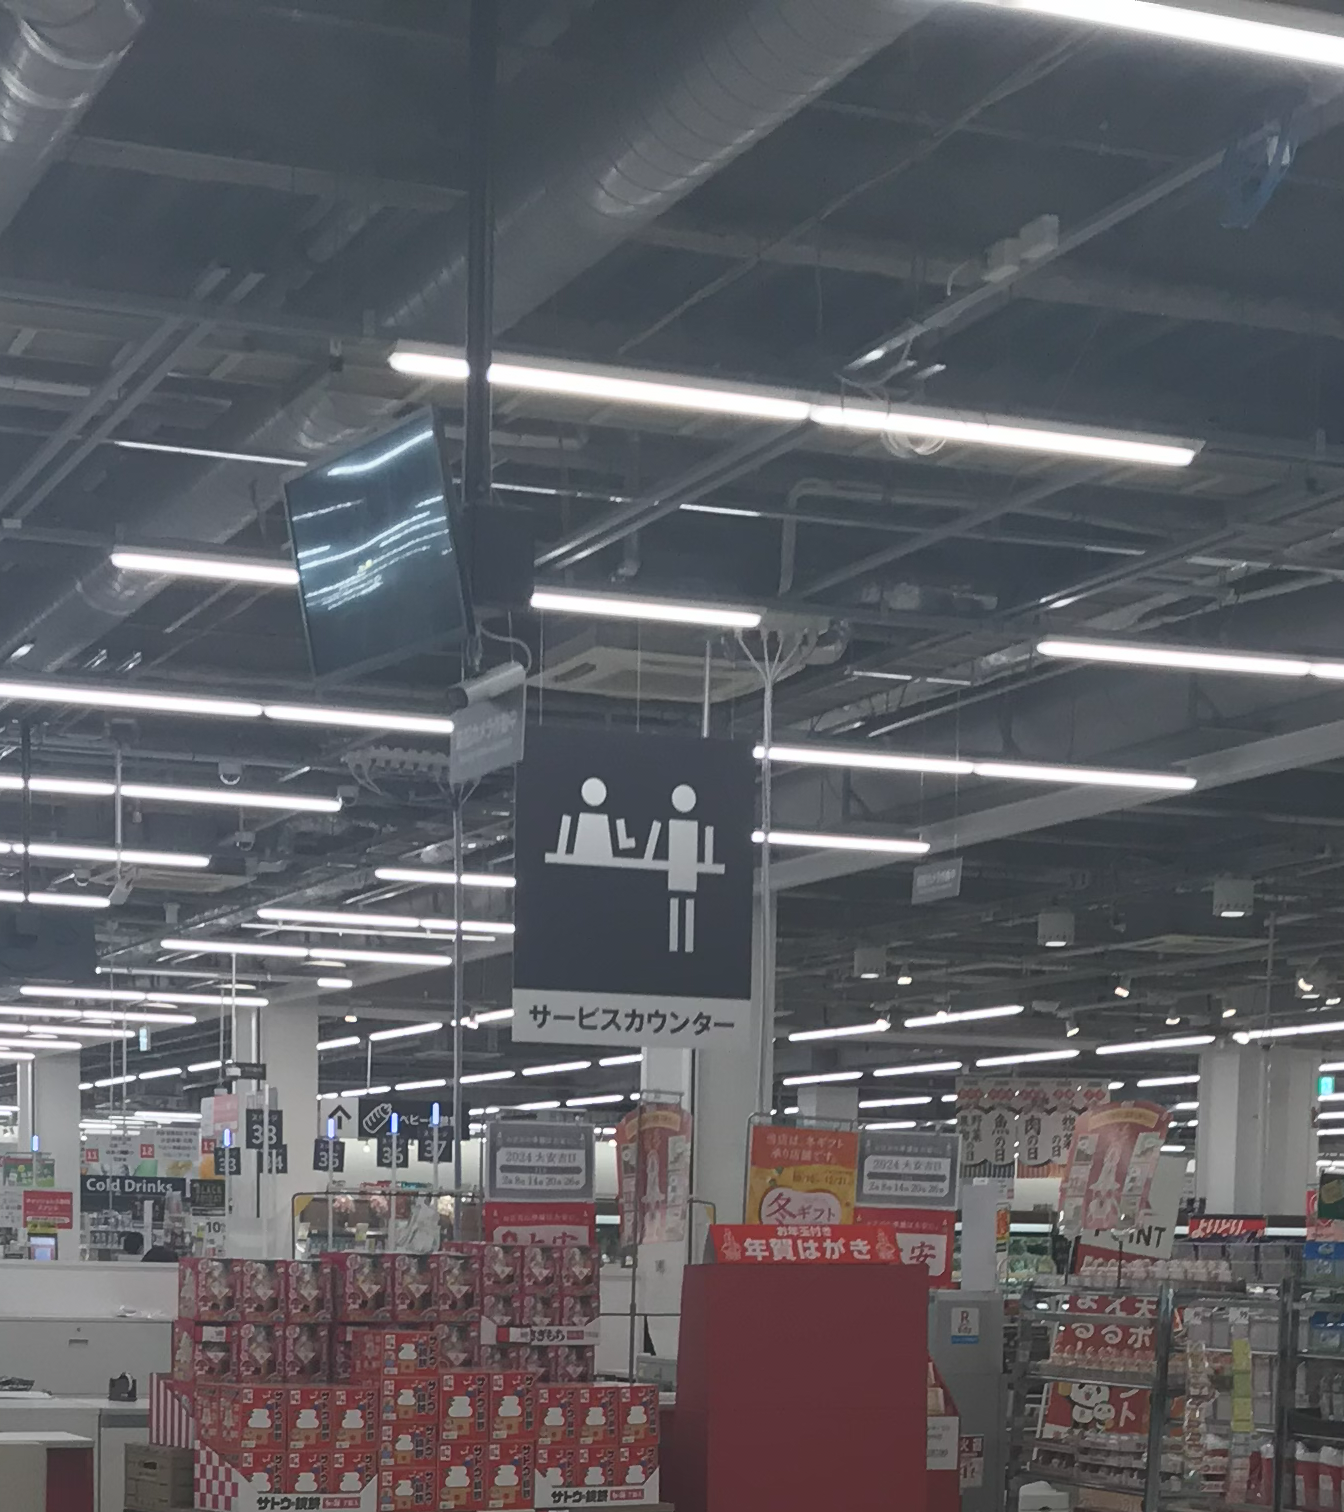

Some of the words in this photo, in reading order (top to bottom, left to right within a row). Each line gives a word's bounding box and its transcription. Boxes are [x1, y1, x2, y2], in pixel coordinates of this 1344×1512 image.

[528, 1004, 735, 1036] サービスカウンター
[252, 1124, 277, 1145] 38
[992, 1113, 1010, 1162] 魚の日
[1024, 1115, 1042, 1161] 肉の日
[382, 1147, 404, 1164] 36
[424, 1139, 447, 1158] 37
[86, 1178, 121, 1192] Cold
[125, 1179, 173, 1193] Drinks
[766, 1191, 836, 1224] 冬ギフト
[776, 1225, 832, 1237] お年玉付き
[743, 1238, 871, 1262] 年賀はがき
